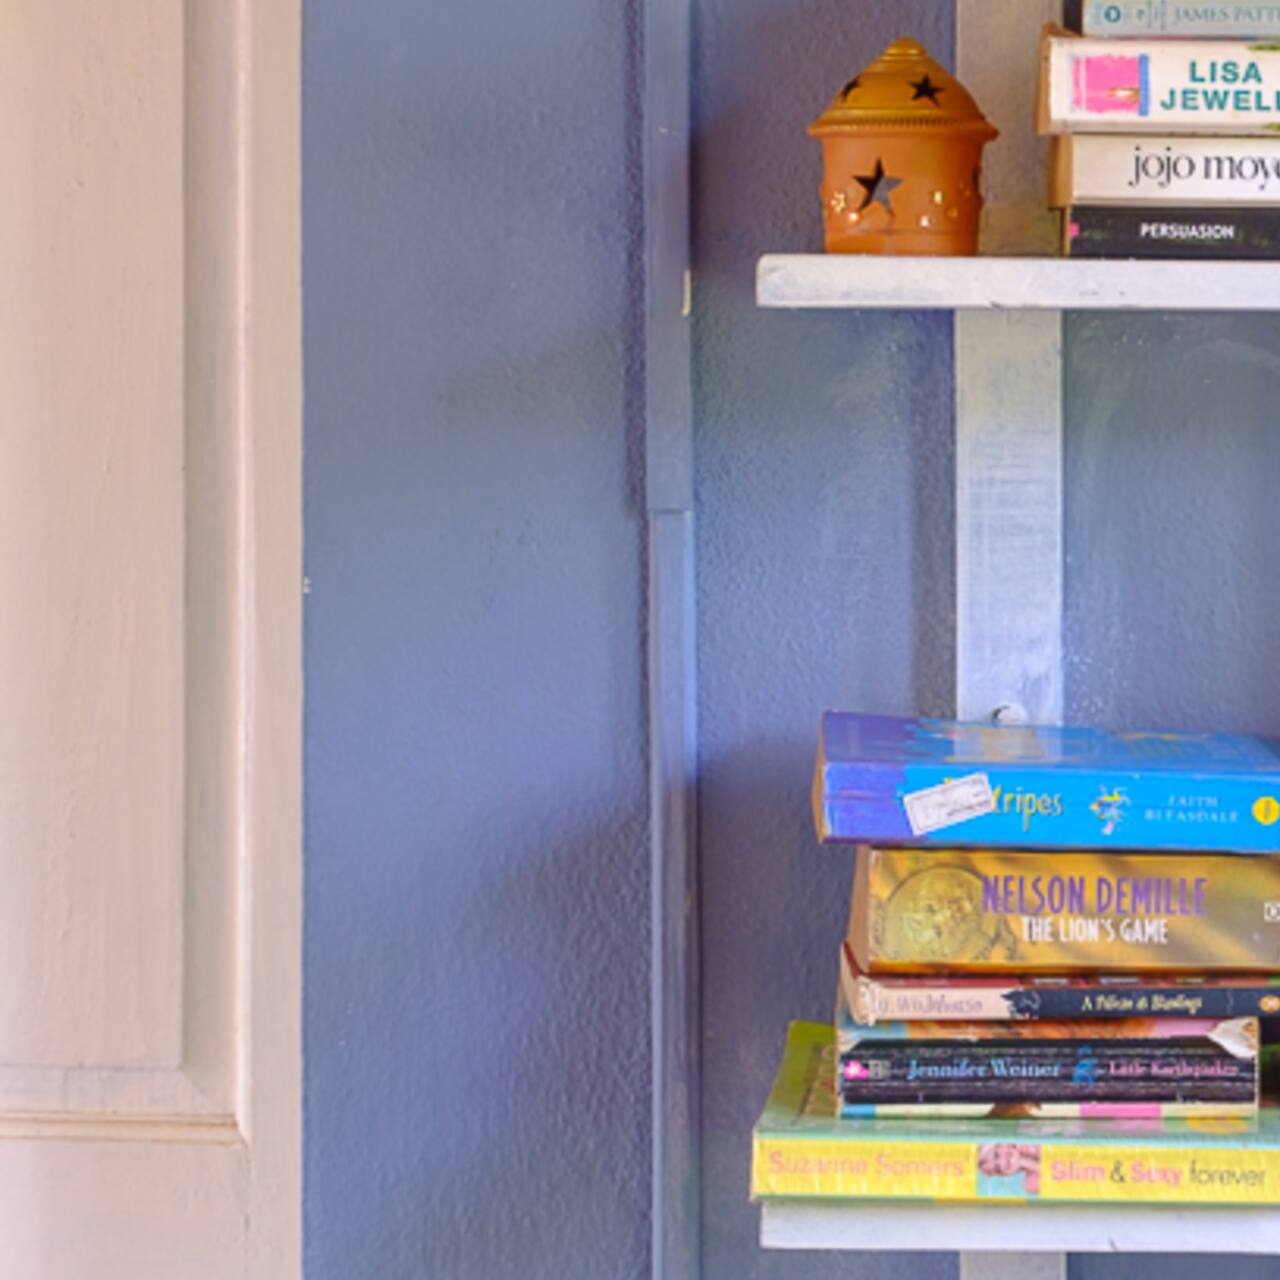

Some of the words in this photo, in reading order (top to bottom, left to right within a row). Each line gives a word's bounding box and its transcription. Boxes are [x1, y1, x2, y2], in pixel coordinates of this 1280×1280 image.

[1172, 5, 1228, 26] JAMES
[1188, 60, 1263, 84] LISA
[1128, 146, 1195, 188] jojo
[1139, 223, 1235, 240] PERSUASION
[1167, 793, 1220, 809] FAITH
[981, 875, 1086, 915] NELSON
[1098, 877, 1208, 918] DEMILLE
[1022, 916, 1056, 943] THE
[1060, 917, 1117, 944] LION'S
[1120, 918, 1169, 945] GAME
[906, 1058, 987, 1081] Jennifer
[990, 1057, 1062, 1078] Weiner
[768, 1151, 869, 1176] Suzanne
[1049, 1160, 1106, 1183] Slim
[1109, 1161, 1127, 1184] &
[1130, 1162, 1184, 1190] Sexy
[1188, 1159, 1266, 1187] forever
